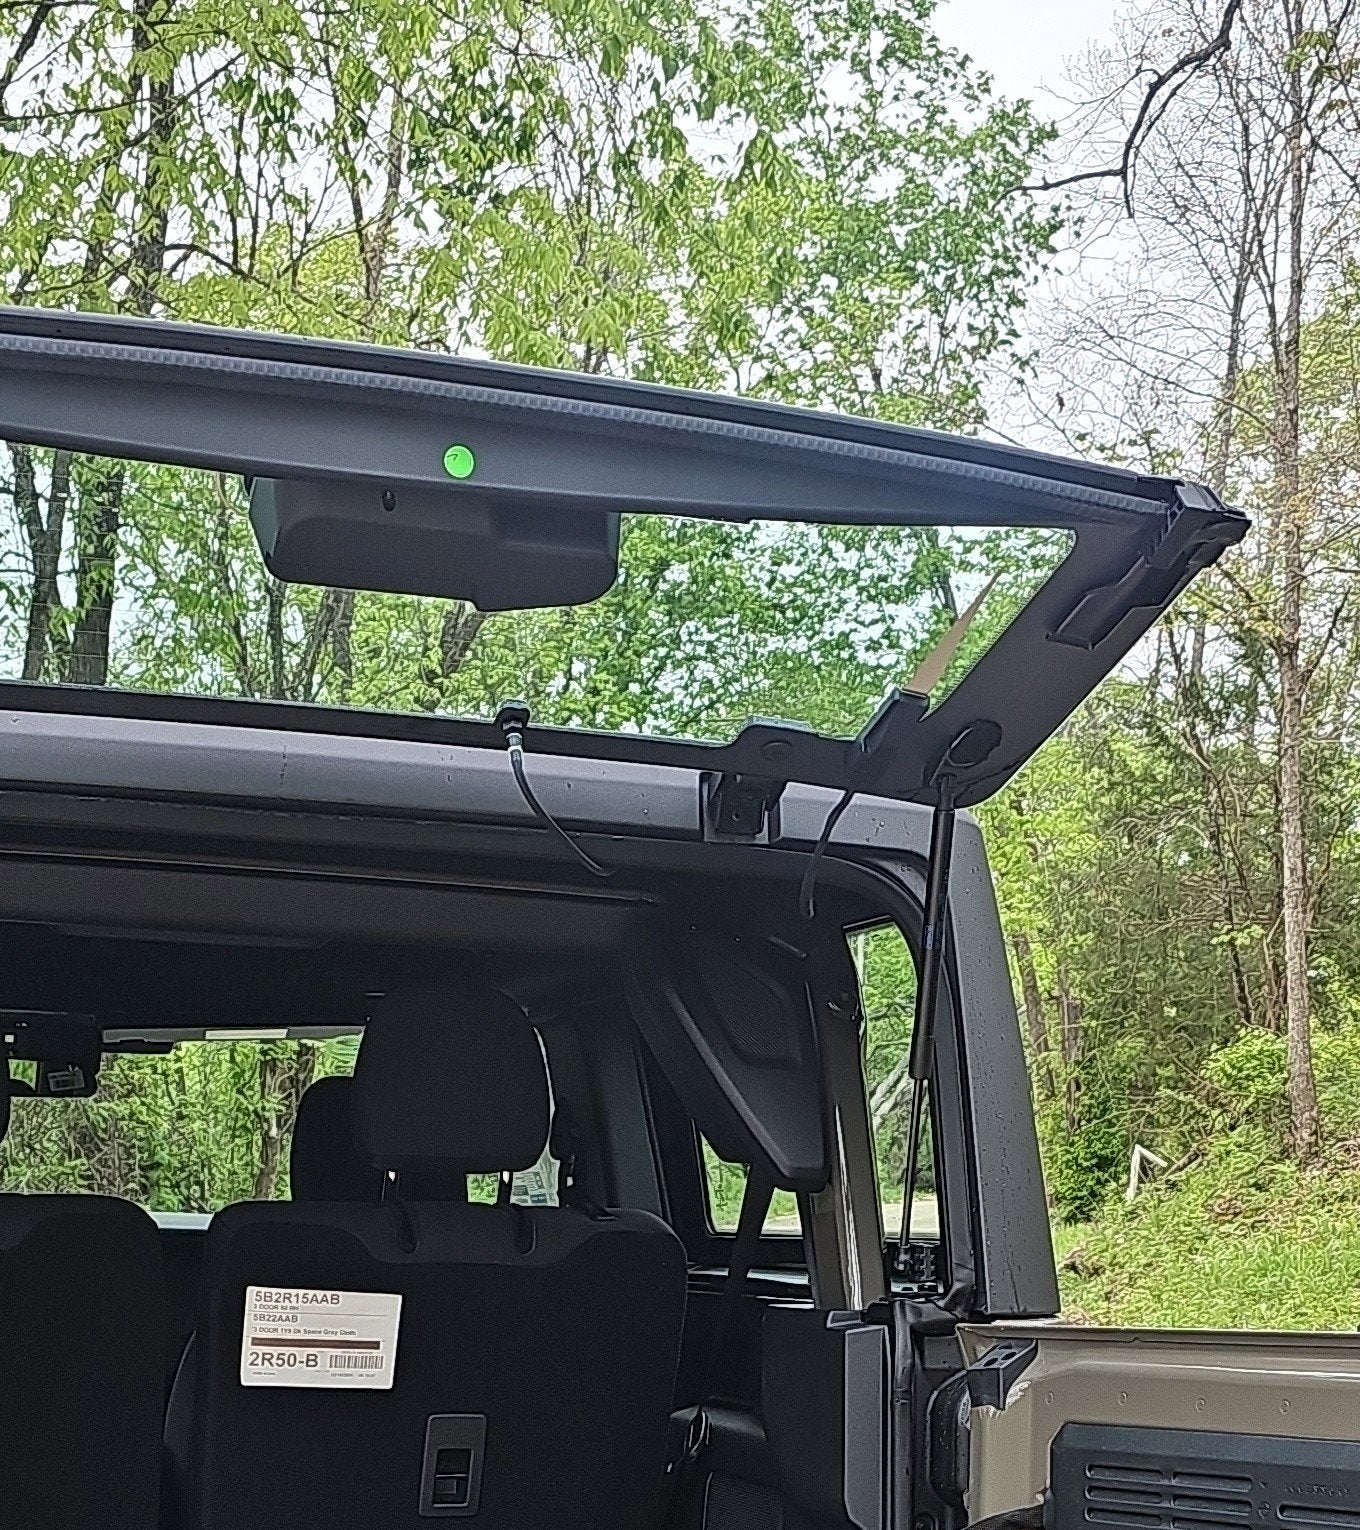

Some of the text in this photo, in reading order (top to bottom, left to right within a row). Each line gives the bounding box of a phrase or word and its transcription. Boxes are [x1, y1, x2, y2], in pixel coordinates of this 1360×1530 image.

[254, 1290, 341, 1305] 5B2R15AAB
[253, 1313, 299, 1323] 5B22AAB
[248, 1351, 319, 1368] 2R50-B
